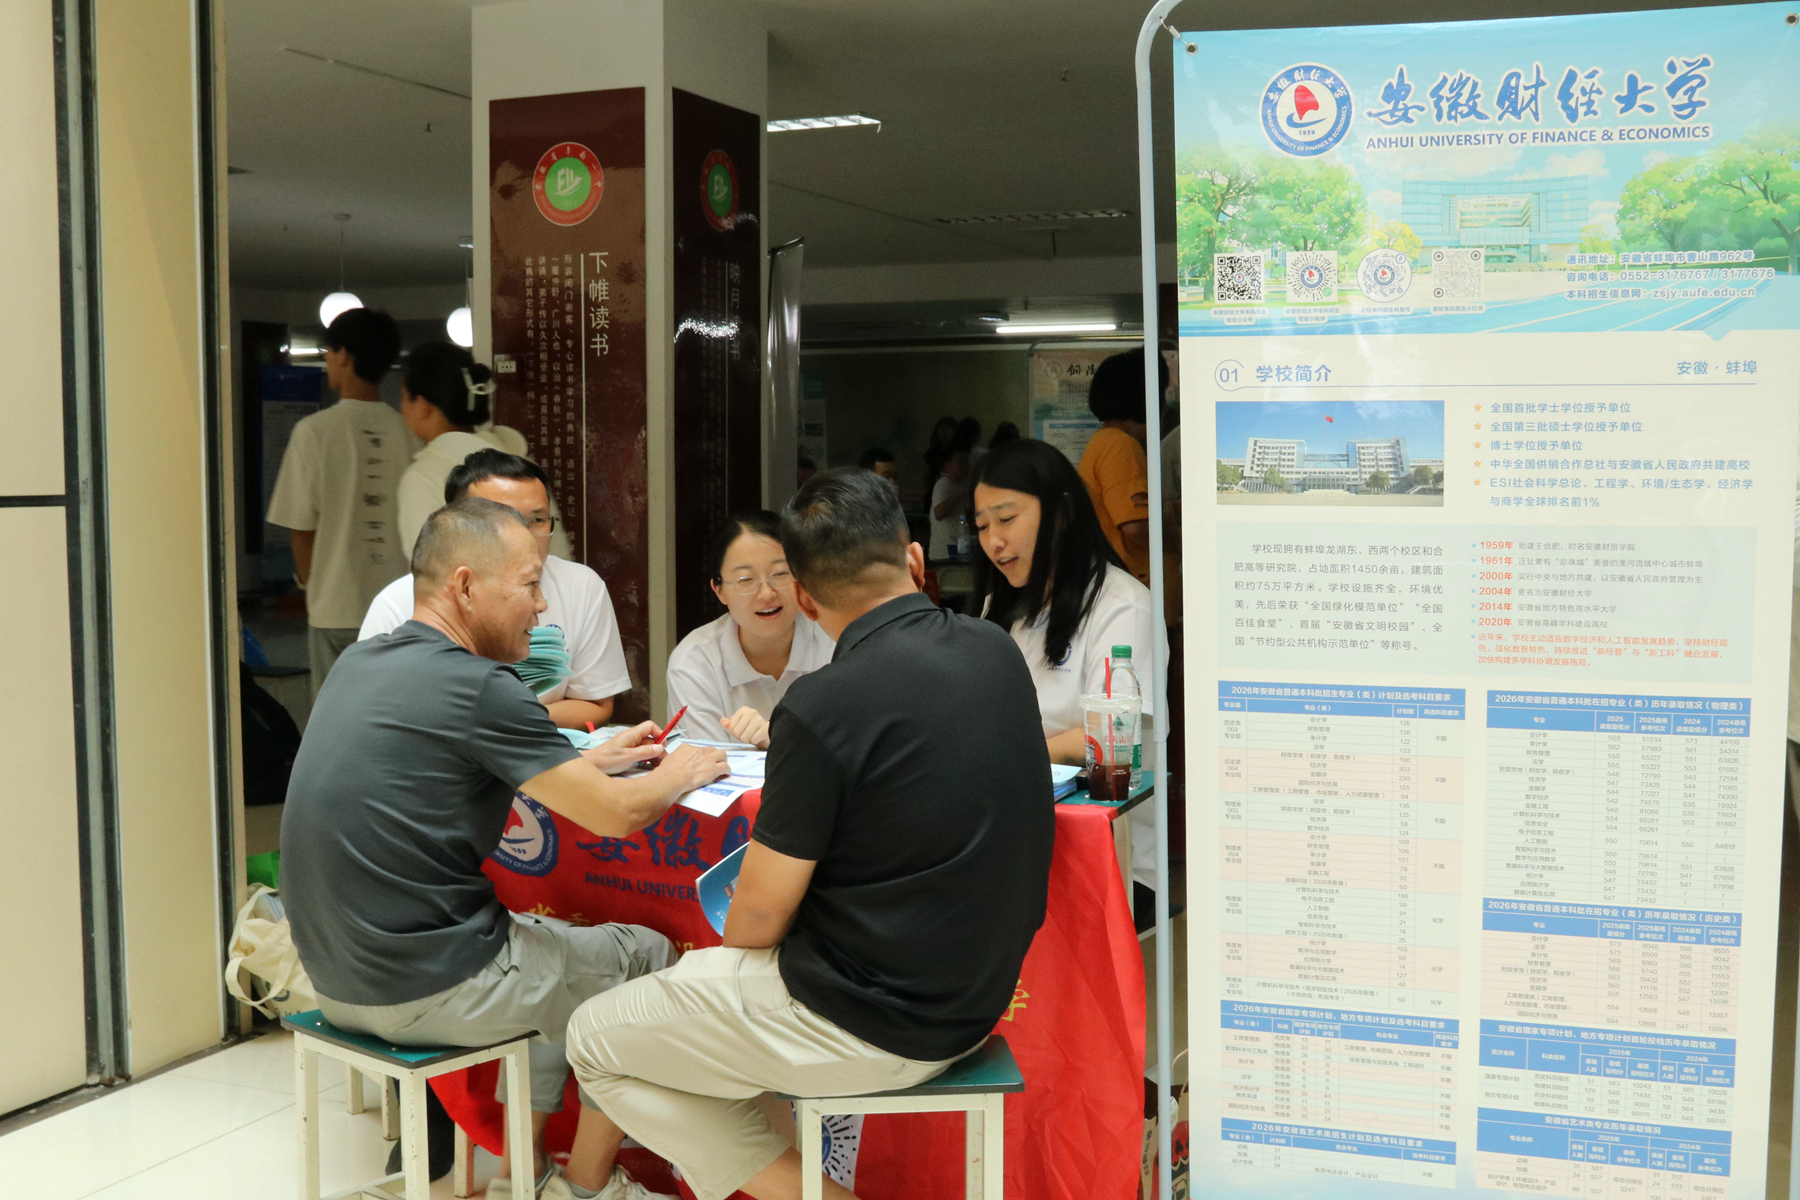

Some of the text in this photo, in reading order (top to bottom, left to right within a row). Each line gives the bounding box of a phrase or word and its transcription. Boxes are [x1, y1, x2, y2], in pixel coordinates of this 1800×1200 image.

[1267, 68, 1347, 104] 安徽财经大学
[1366, 57, 1711, 125] 安徽财经大学
[1271, 126, 1297, 150] UNIVERSITY
[1305, 141, 1329, 151] FINANCE
[1332, 106, 1347, 138] ECONOMICS
[1366, 125, 1710, 149] ANHUI UNIVERSITY OF FINANCE & ECONOMICS
[1566, 251, 1755, 265] 通讯地址：安徽省蚌埠市曹山路962号
[1566, 270, 1709, 282] 咨询电话：0552-3176767
[1721, 268, 1774, 279] 3177676
[1566, 287, 1755, 299] 本科招生信息网：zsjy.aufe.edu.cn
[589, 252, 609, 357] 下帷读书
[730, 262, 740, 361] 映月书
[1432, 305, 1484, 313] 安财本科招生小红书
[1213, 308, 1266, 317] 安徽财经大学本科招生
[1220, 368, 1238, 383] 01
[1256, 364, 1332, 382] 学校简介
[1490, 402, 1631, 414] 全国首批学士学位授予单位
[1490, 421, 1643, 432] 全国第三批硕士学位授予单位
[1490, 440, 1583, 451] 博士学位授予单位
[1490, 459, 1750, 470] 中华全国供销合作总社与安徽省人民政府共建高校
[1490, 478, 1753, 490] ESI社会科学总论、工程学、环境/生态学、经济学
[1490, 496, 1600, 508] 与商学全球排名前1%
[1252, 544, 1443, 556] 学校现拥有蚌埠龙湖东、西两个校区和合
[1480, 541, 1513, 550] 1959年
[1480, 556, 1513, 565] 1961年
[1234, 562, 1443, 576] 肥高等研究院，占地面积1450余亩，建筑面
[1480, 572, 1702, 584] 2000年 实行中央与地方共建，以安徽省人民政府管理为主
[1234, 581, 1443, 594] 积约75万平方米。学校设施齐全，环境优
[1479, 587, 1592, 597] 2004年 更名为安徽财经大学
[1479, 602, 1617, 613] 2014年 安徽省地方特色高水平大学
[1479, 618, 1608, 628] 2020年 安徽省高峰学科建设高校
[1235, 636, 1418, 651] 国“节约型公共机构示范单位”等称号。
[1478, 655, 1591, 666] 加快构建多学科协调发展格局。
[1232, 686, 1451, 702] 2026年安徽省普通本科批招生专业（类）计划及选考科目要求
[1495, 694, 1744, 711] 2026年安徽省普通本科批在招专业（类）历年录取情况（物理类）
[586, 872, 699, 902] ANHUI UNIVER
[1488, 901, 1738, 924] 2026年安徽省普通本科批在招专业（类）历年录取情况（历史类）
[1233, 1004, 1445, 1029] 2026年安徽省国家专项计划、地方专项计划及选考科目要求
[1498, 1024, 1716, 1049] 安徽省国家专项计划、地方专项计划首轮投档历年录取情况
[1544, 1116, 1661, 1135] 安徽省艺术类专业历年录取情况
[1252, 1122, 1423, 1148] 2026年安徽省艺术类招生计划及选考科目要求
